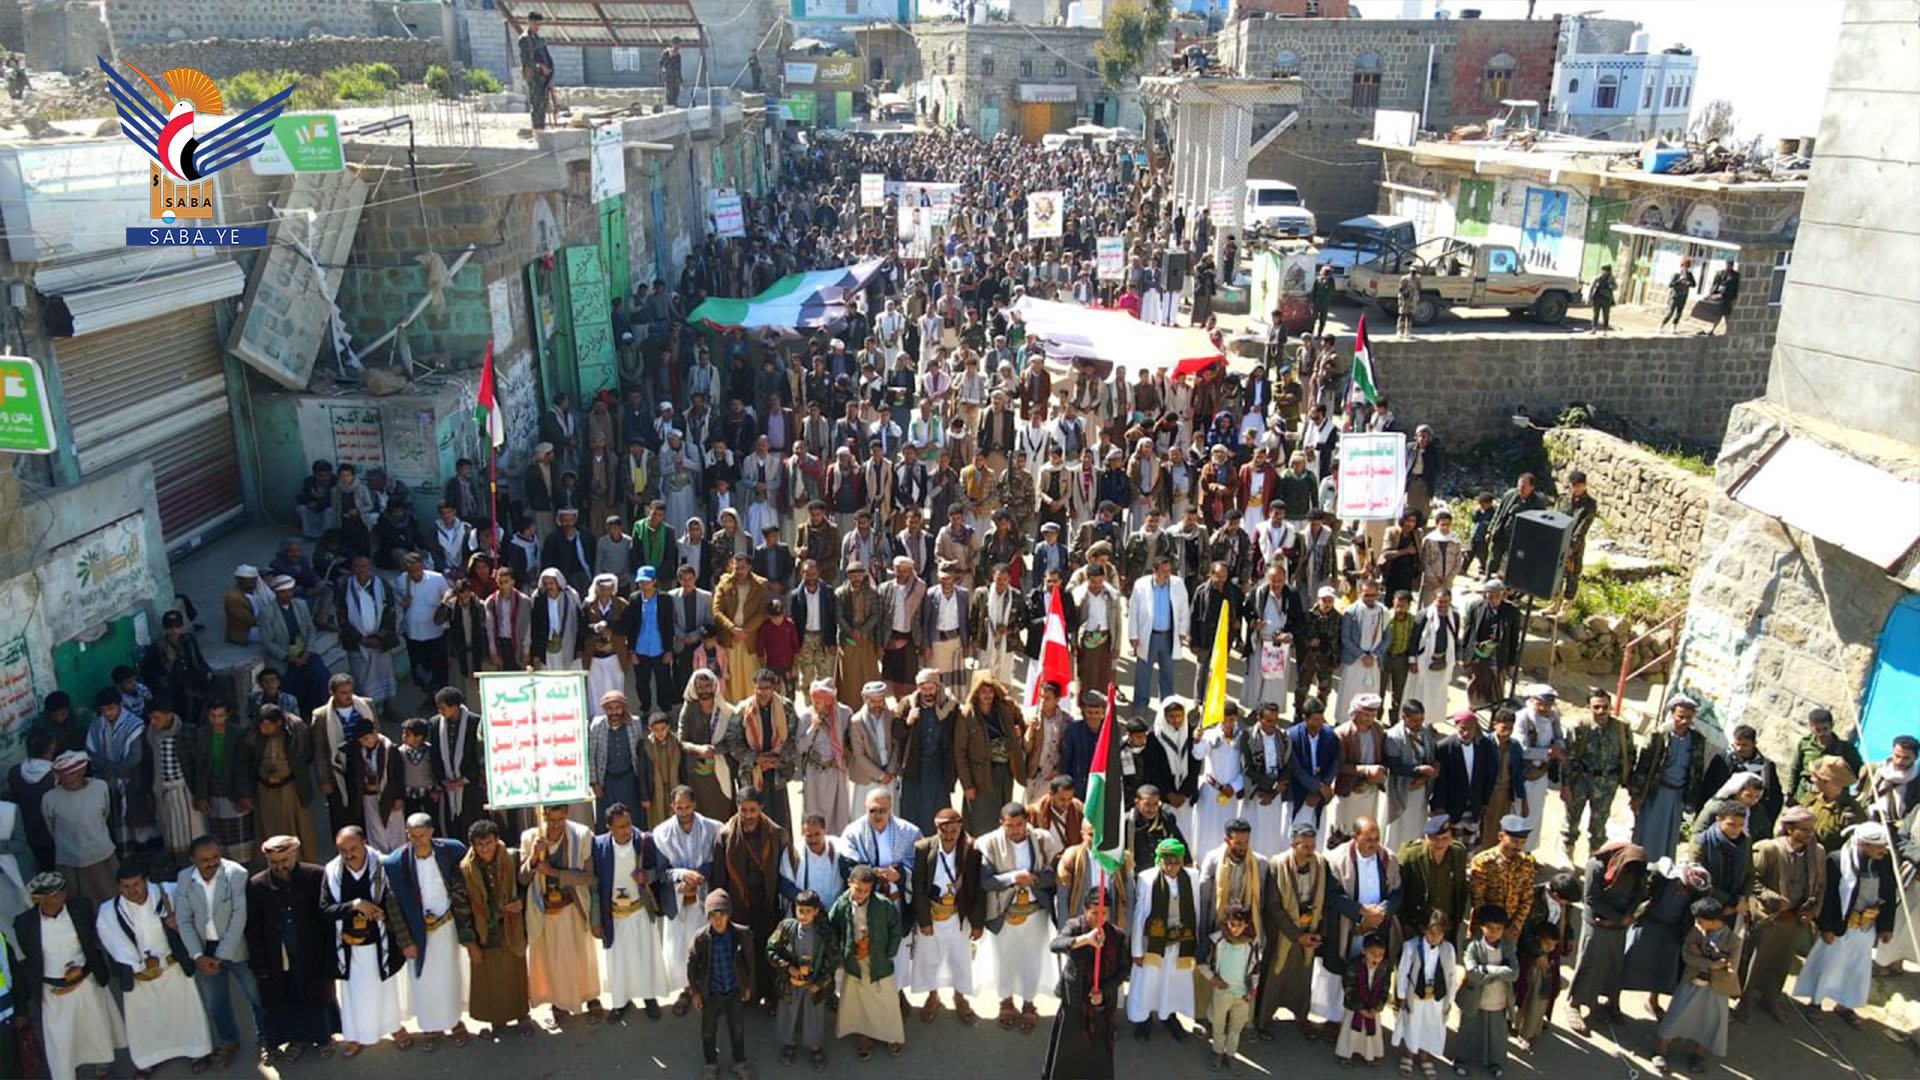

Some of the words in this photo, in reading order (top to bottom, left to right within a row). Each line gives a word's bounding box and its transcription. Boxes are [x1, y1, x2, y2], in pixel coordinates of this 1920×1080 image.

[546, 682, 578, 699] الله
[541, 707, 579, 724] الموت
[543, 728, 582, 747] الموت
[493, 755, 526, 775] اليهود
[531, 756, 548, 772] على
[552, 751, 582, 767] اللعنة
[546, 771, 582, 798] النصر
